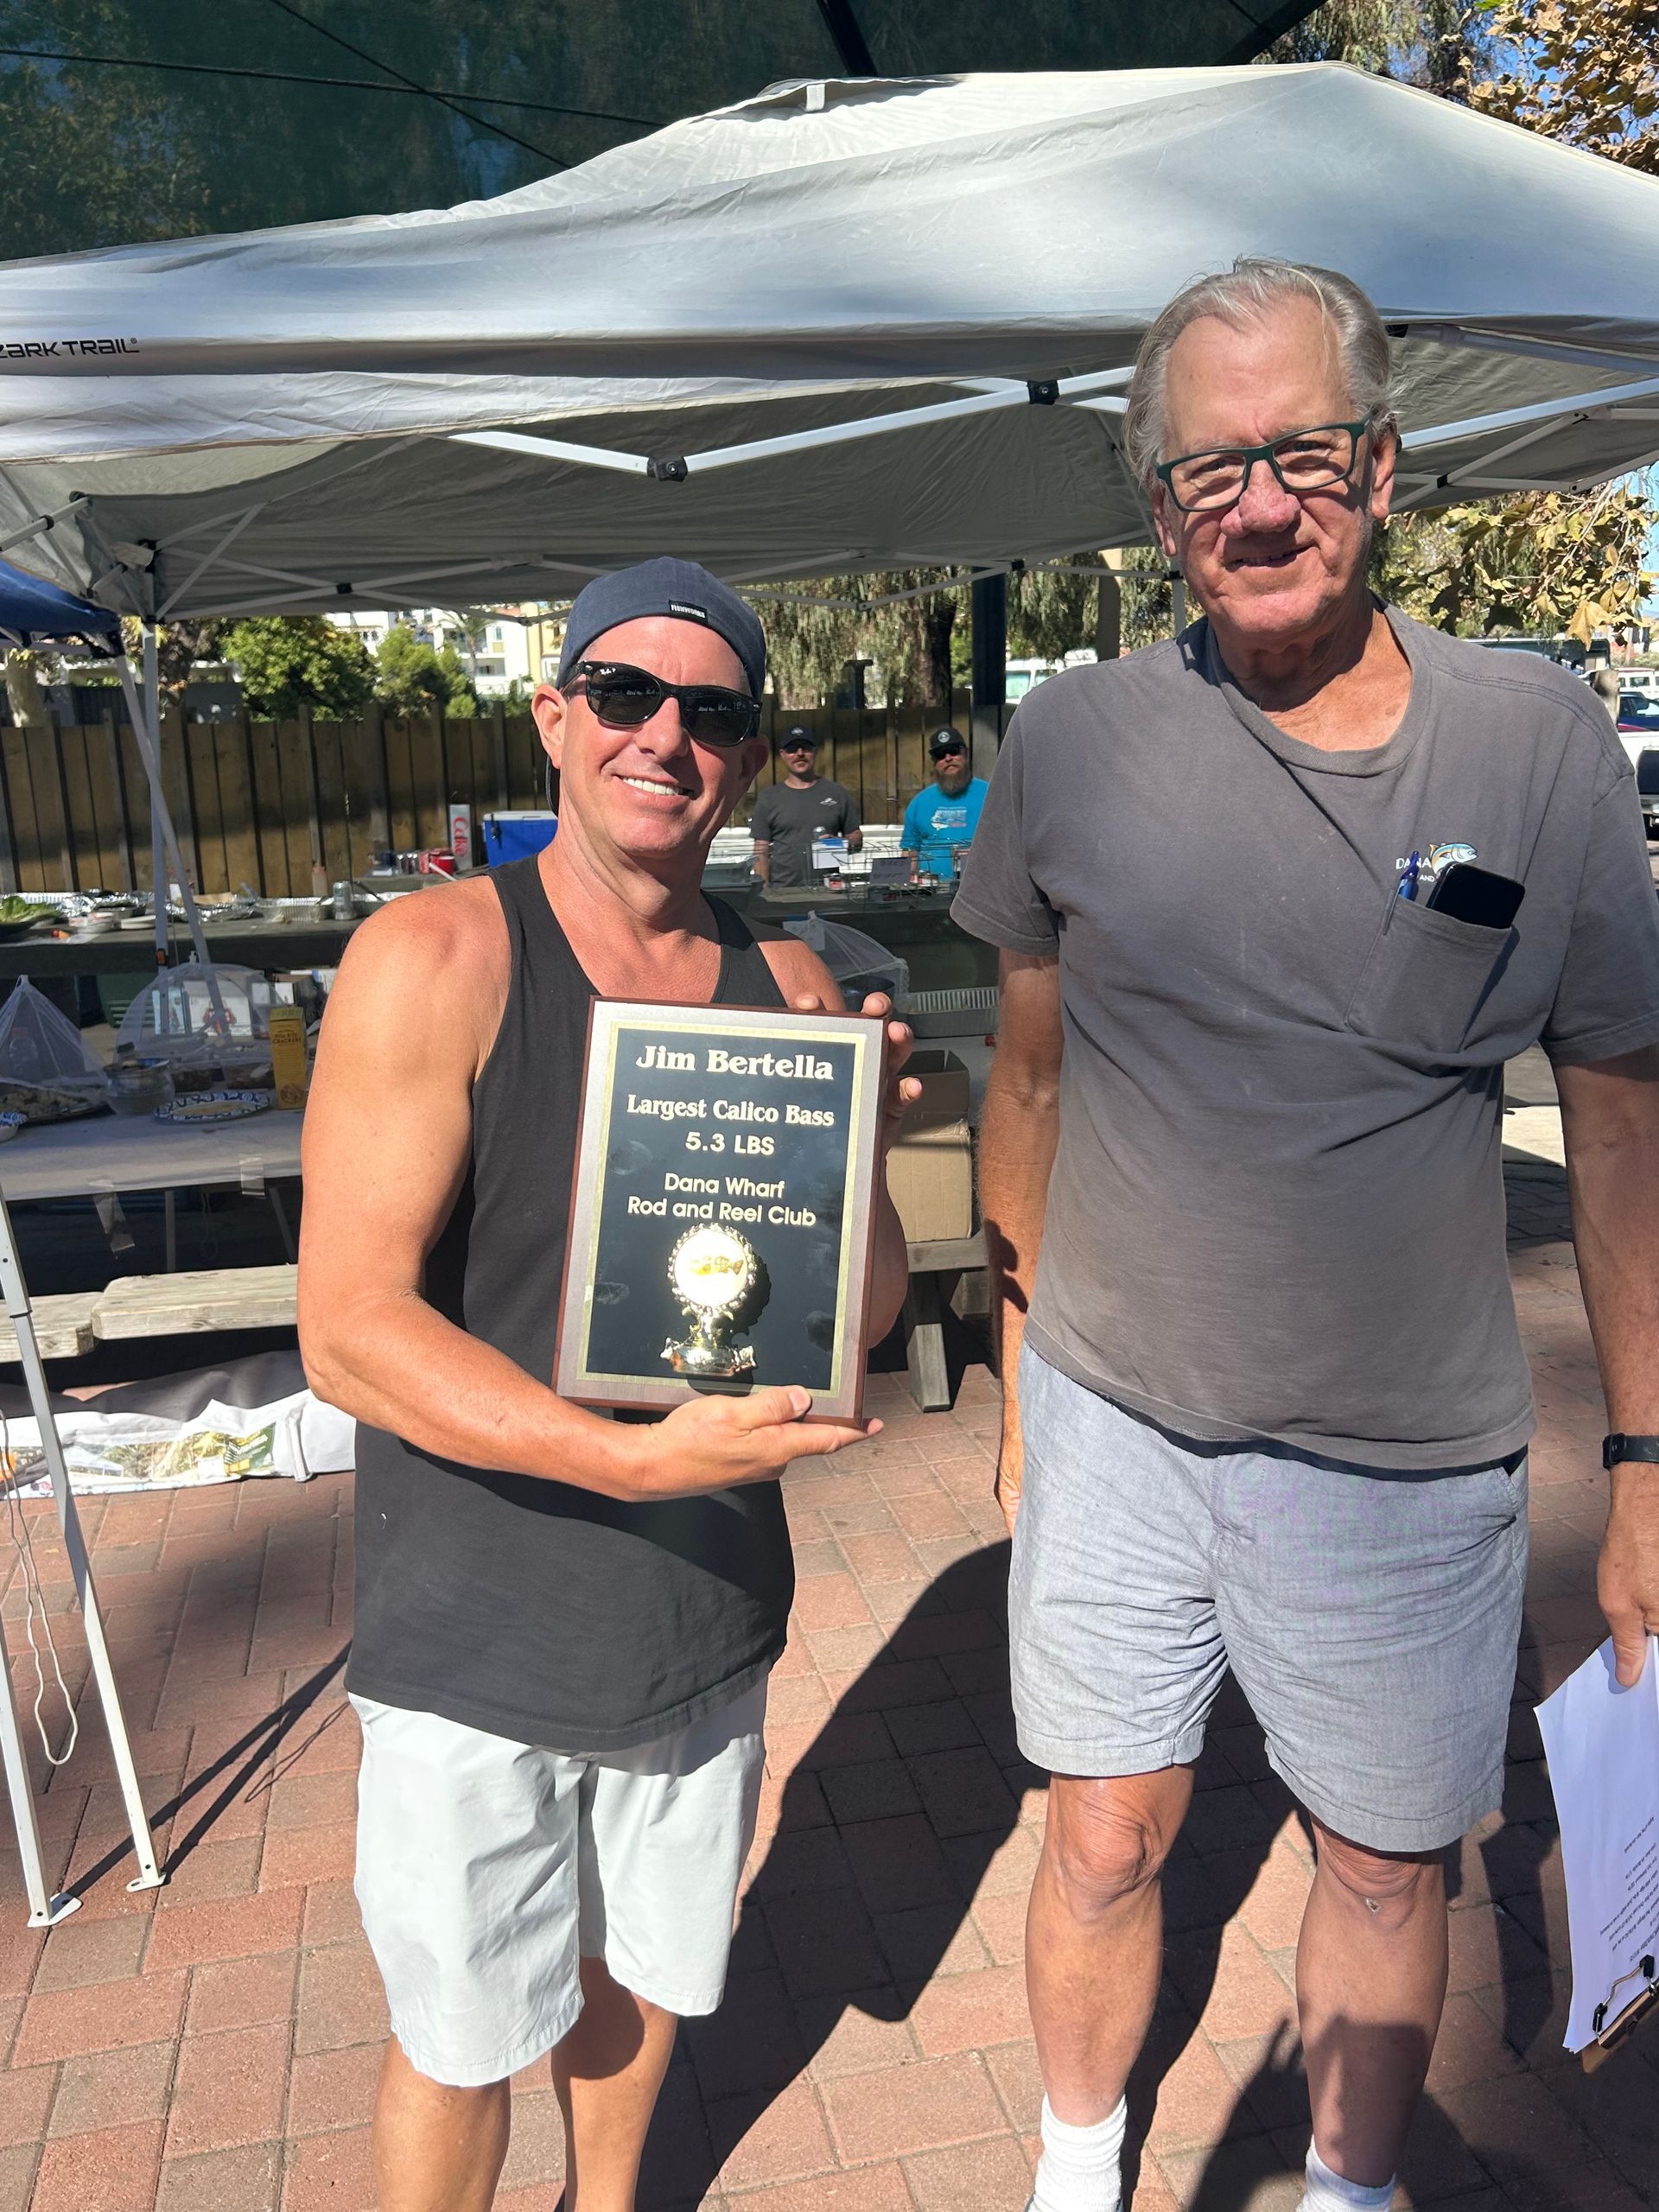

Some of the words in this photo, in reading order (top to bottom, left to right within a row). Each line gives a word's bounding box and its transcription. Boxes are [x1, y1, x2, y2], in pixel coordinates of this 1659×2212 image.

[635, 1045, 696, 1071] Jim
[707, 1049, 835, 1080] Bertella
[626, 1094, 707, 1122] Largest
[713, 1099, 779, 1123] Calico
[785, 1104, 835, 1127] Bass
[684, 1131, 726, 1153] 5.3
[734, 1134, 775, 1156] LBS
[664, 1172, 720, 1194] Dana
[724, 1176, 785, 1199] Wharf
[627, 1195, 668, 1217] Rod
[671, 1201, 715, 1219] and
[718, 1202, 763, 1224] Reel
[767, 1205, 817, 1228] Club
